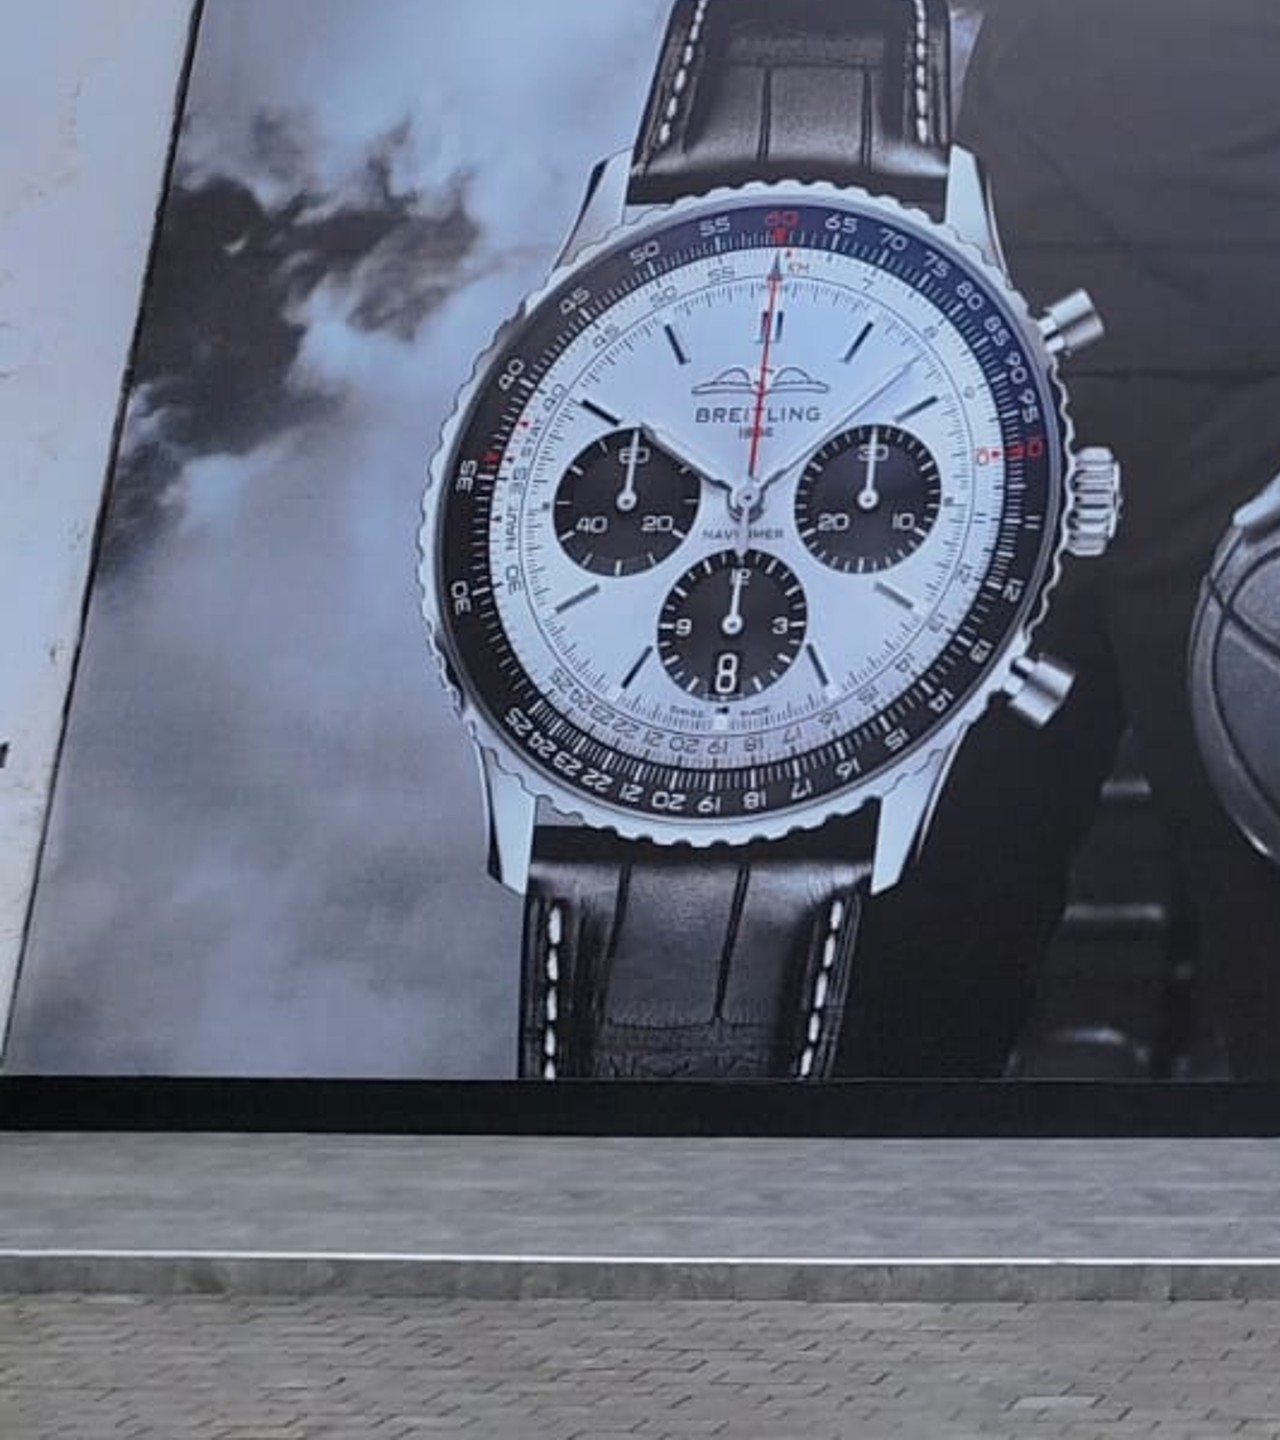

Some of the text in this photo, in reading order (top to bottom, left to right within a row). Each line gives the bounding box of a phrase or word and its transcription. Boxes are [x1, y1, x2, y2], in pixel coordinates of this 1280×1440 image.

[700, 216, 730, 236] 55
[825, 214, 858, 234] 65
[878, 228, 908, 250] 70
[629, 240, 661, 265] 50
[922, 251, 950, 279] 75
[559, 287, 591, 314] 45
[956, 280, 985, 310] 80
[499, 359, 524, 390] 40
[1005, 351, 1027, 384] 90
[1017, 388, 1040, 423] 95
[456, 460, 477, 492] 35
[576, 516, 608, 534] 40
[641, 515, 674, 532] 20
[818, 513, 849, 531] 20
[892, 513, 915, 530] 10
[451, 581, 471, 615] 30
[1002, 578, 1024, 602] 12
[675, 618, 692, 636] 9
[772, 617, 789, 635] 3
[505, 707, 533, 737] 25
[528, 731, 557, 759] 24
[884, 728, 910, 751] 15
[553, 750, 583, 777] 23
[836, 758, 861, 780] 16
[580, 768, 614, 792] 22
[791, 778, 813, 800] 17
[619, 782, 643, 803] 21
[652, 791, 686, 810] 20
[698, 795, 721, 812] 19
[743, 791, 767, 809] 18
